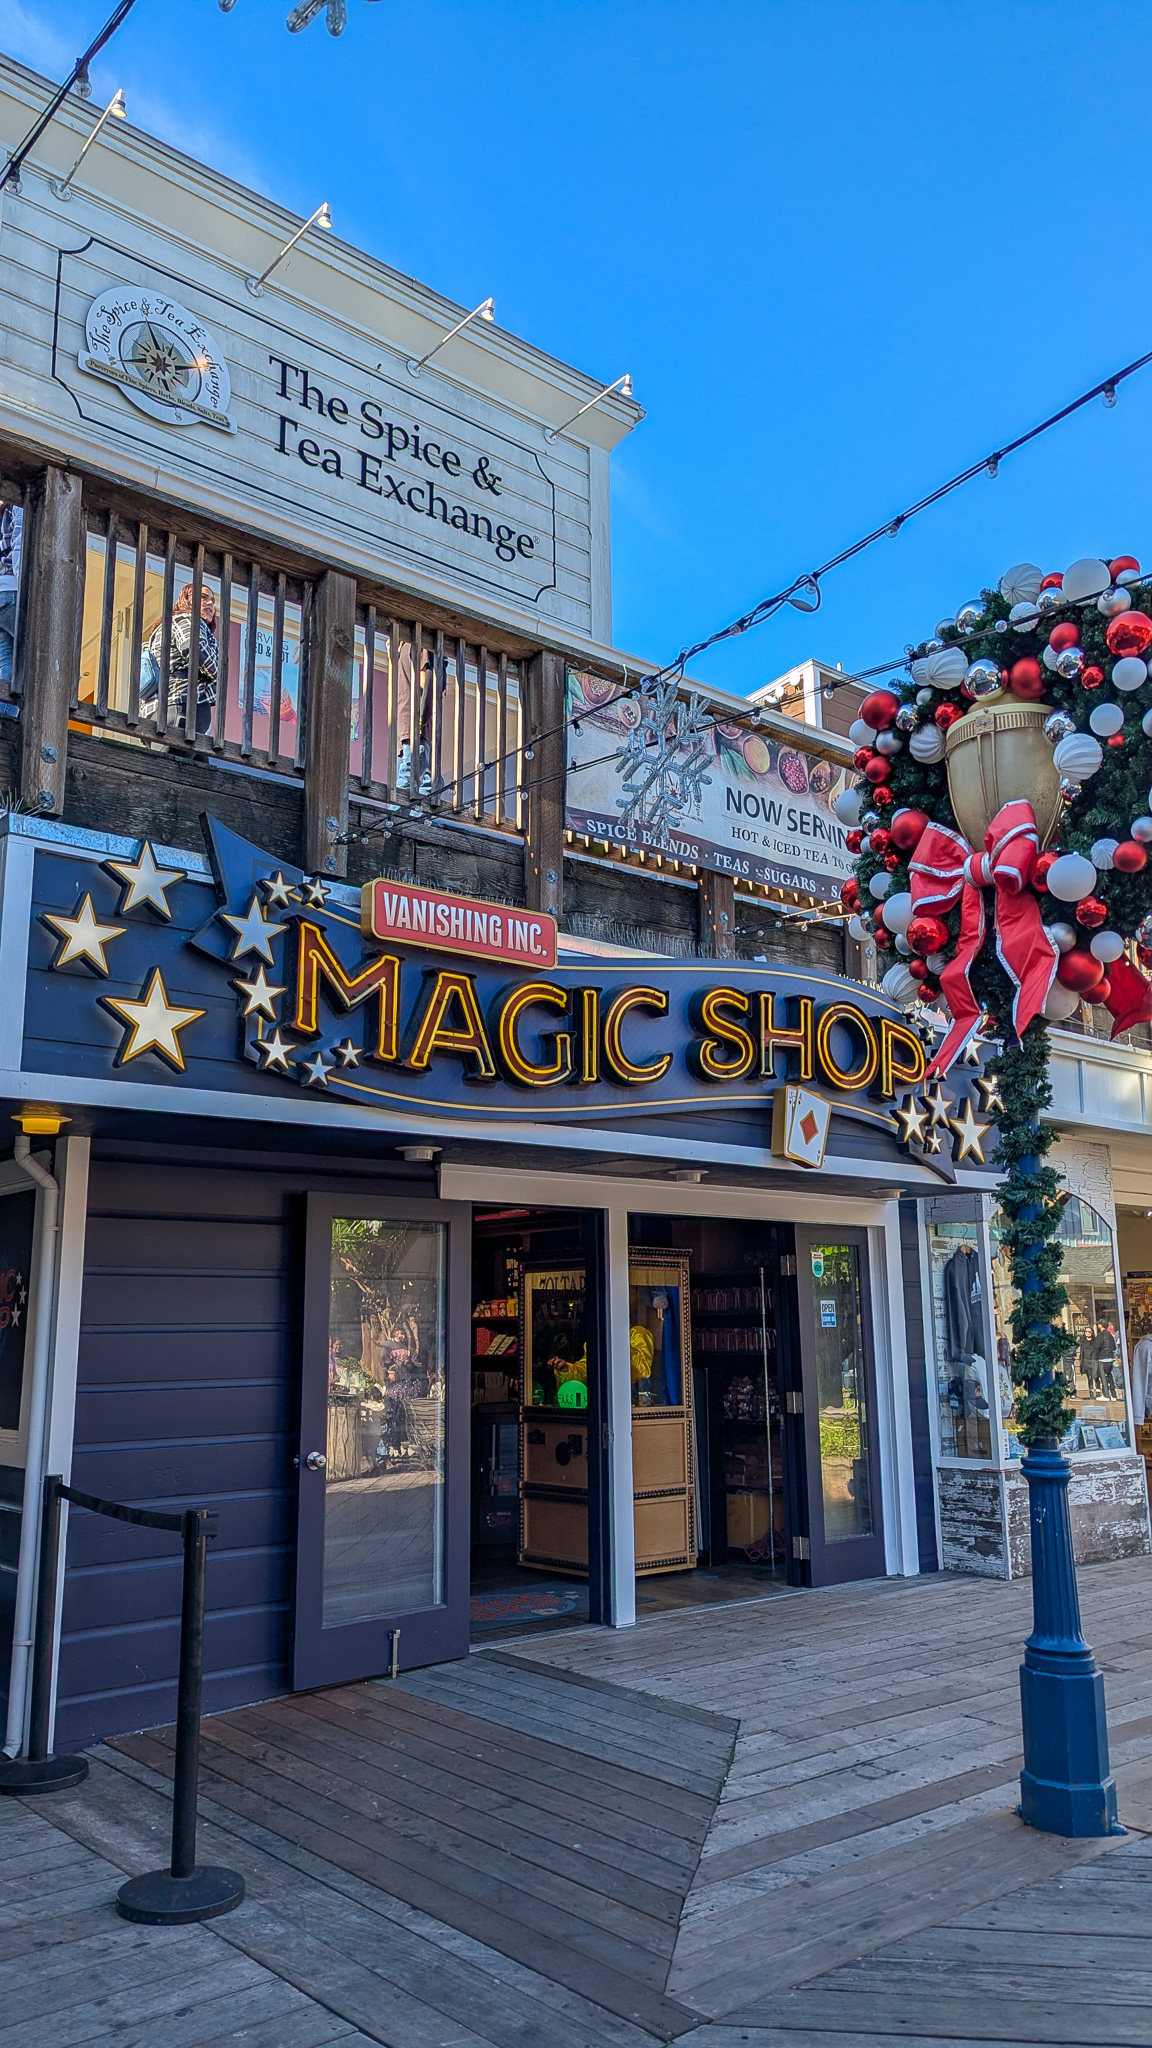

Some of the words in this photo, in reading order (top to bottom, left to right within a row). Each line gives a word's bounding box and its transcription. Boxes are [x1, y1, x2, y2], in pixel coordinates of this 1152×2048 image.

[88, 326, 111, 353] The
[96, 301, 138, 327] Spice
[154, 298, 185, 328] Tea
[269, 354, 349, 426] The
[360, 400, 461, 478] Spice
[472, 456, 503, 497] &
[274, 414, 344, 480] Tea
[726, 786, 783, 827] NOW
[786, 807, 850, 850] SERVIN
[731, 826, 759, 844] HOT
[761, 835, 771, 848] &
[773, 838, 801, 857] ICED
[803, 848, 829, 865] TEA
[831, 855, 845, 871] TO
[586, 819, 638, 842] SPICE
[641, 829, 700, 860] BLENDS
[713, 851, 750, 875] TEAS
[763, 866, 817, 893] SUGARS
[382, 891, 503, 948] VANISHING
[507, 918, 548, 957] INC.
[290, 916, 674, 1088] MAGIC
[692, 984, 927, 1101] SHOP
[822, 1303, 835, 1313] OPEN
